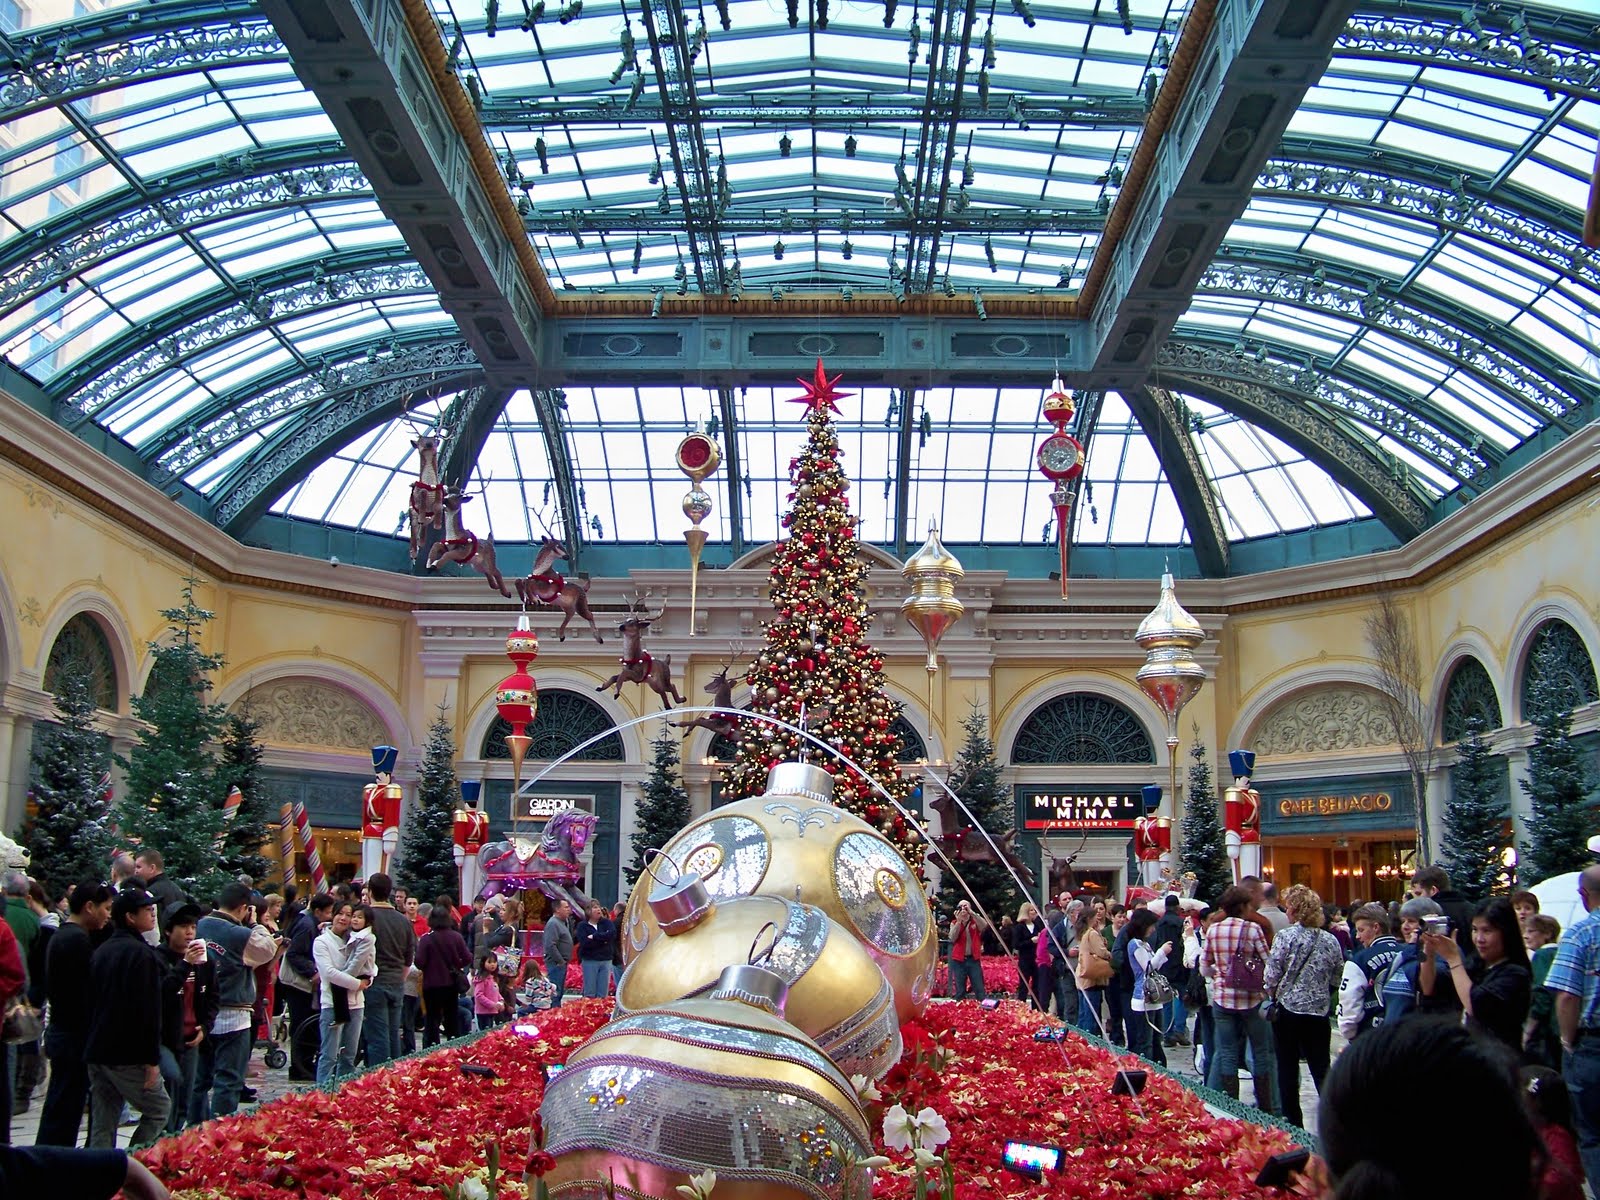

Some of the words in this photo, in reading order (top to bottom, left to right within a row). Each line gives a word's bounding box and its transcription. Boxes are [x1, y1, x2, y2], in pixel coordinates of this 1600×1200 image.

[529, 798, 575, 809] GIARDINI
[1034, 795, 1134, 808] MICHAEL
[1280, 798, 1315, 816] CAFE
[1056, 807, 1113, 820] MINA
